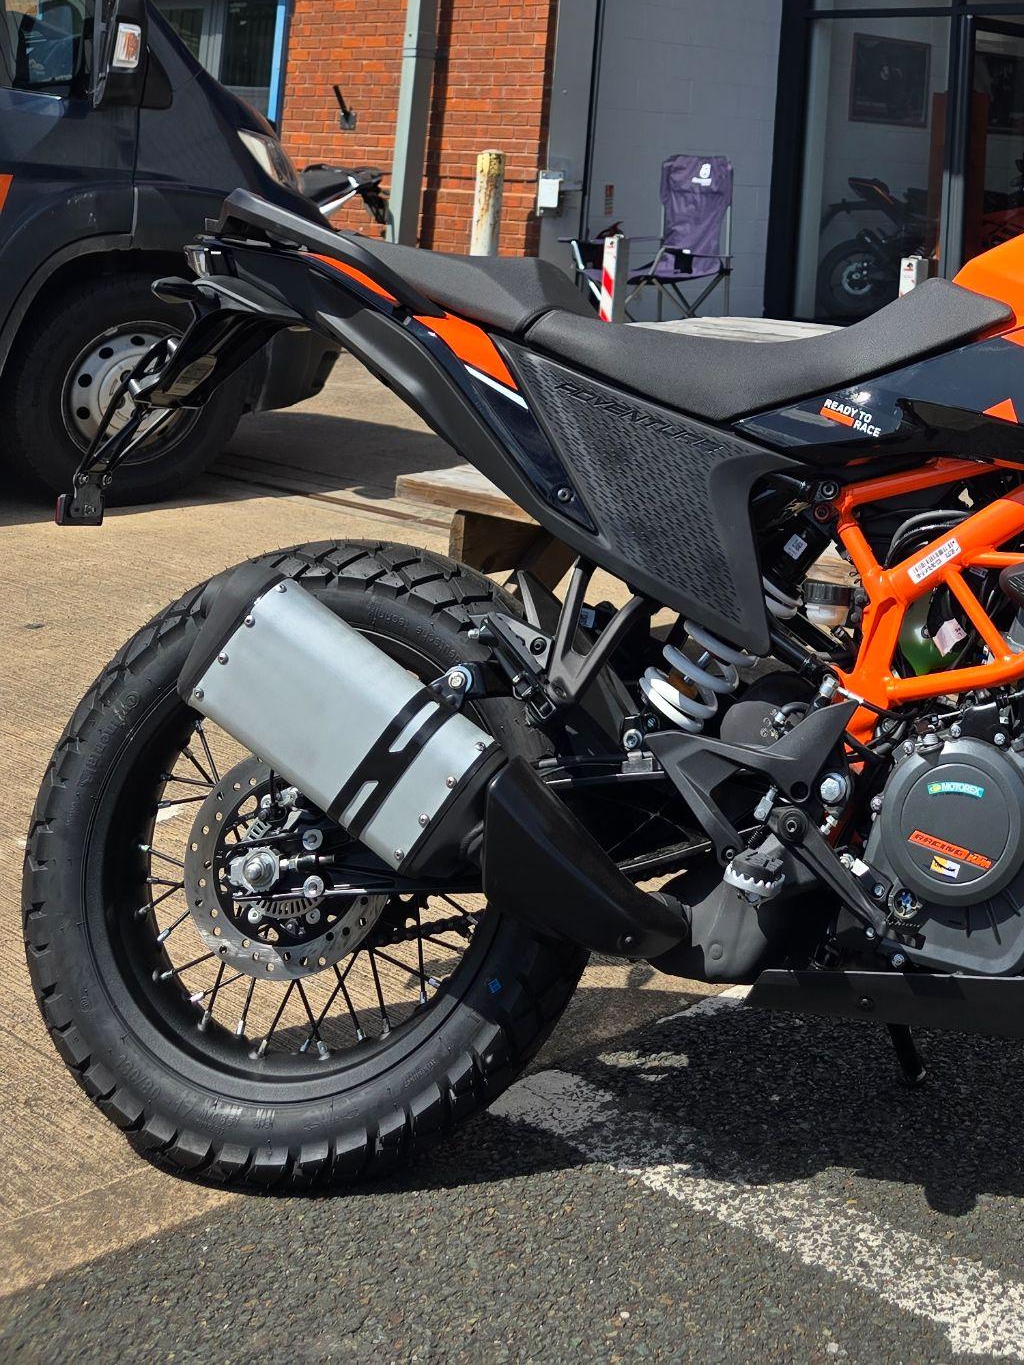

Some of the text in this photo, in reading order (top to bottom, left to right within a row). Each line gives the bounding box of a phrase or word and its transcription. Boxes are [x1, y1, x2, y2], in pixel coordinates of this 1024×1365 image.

[823, 398, 873, 424] READY TO
[853, 419, 882, 438] RACE
[941, 781, 981, 798] MOTOREX
[914, 833, 964, 857] RACING
